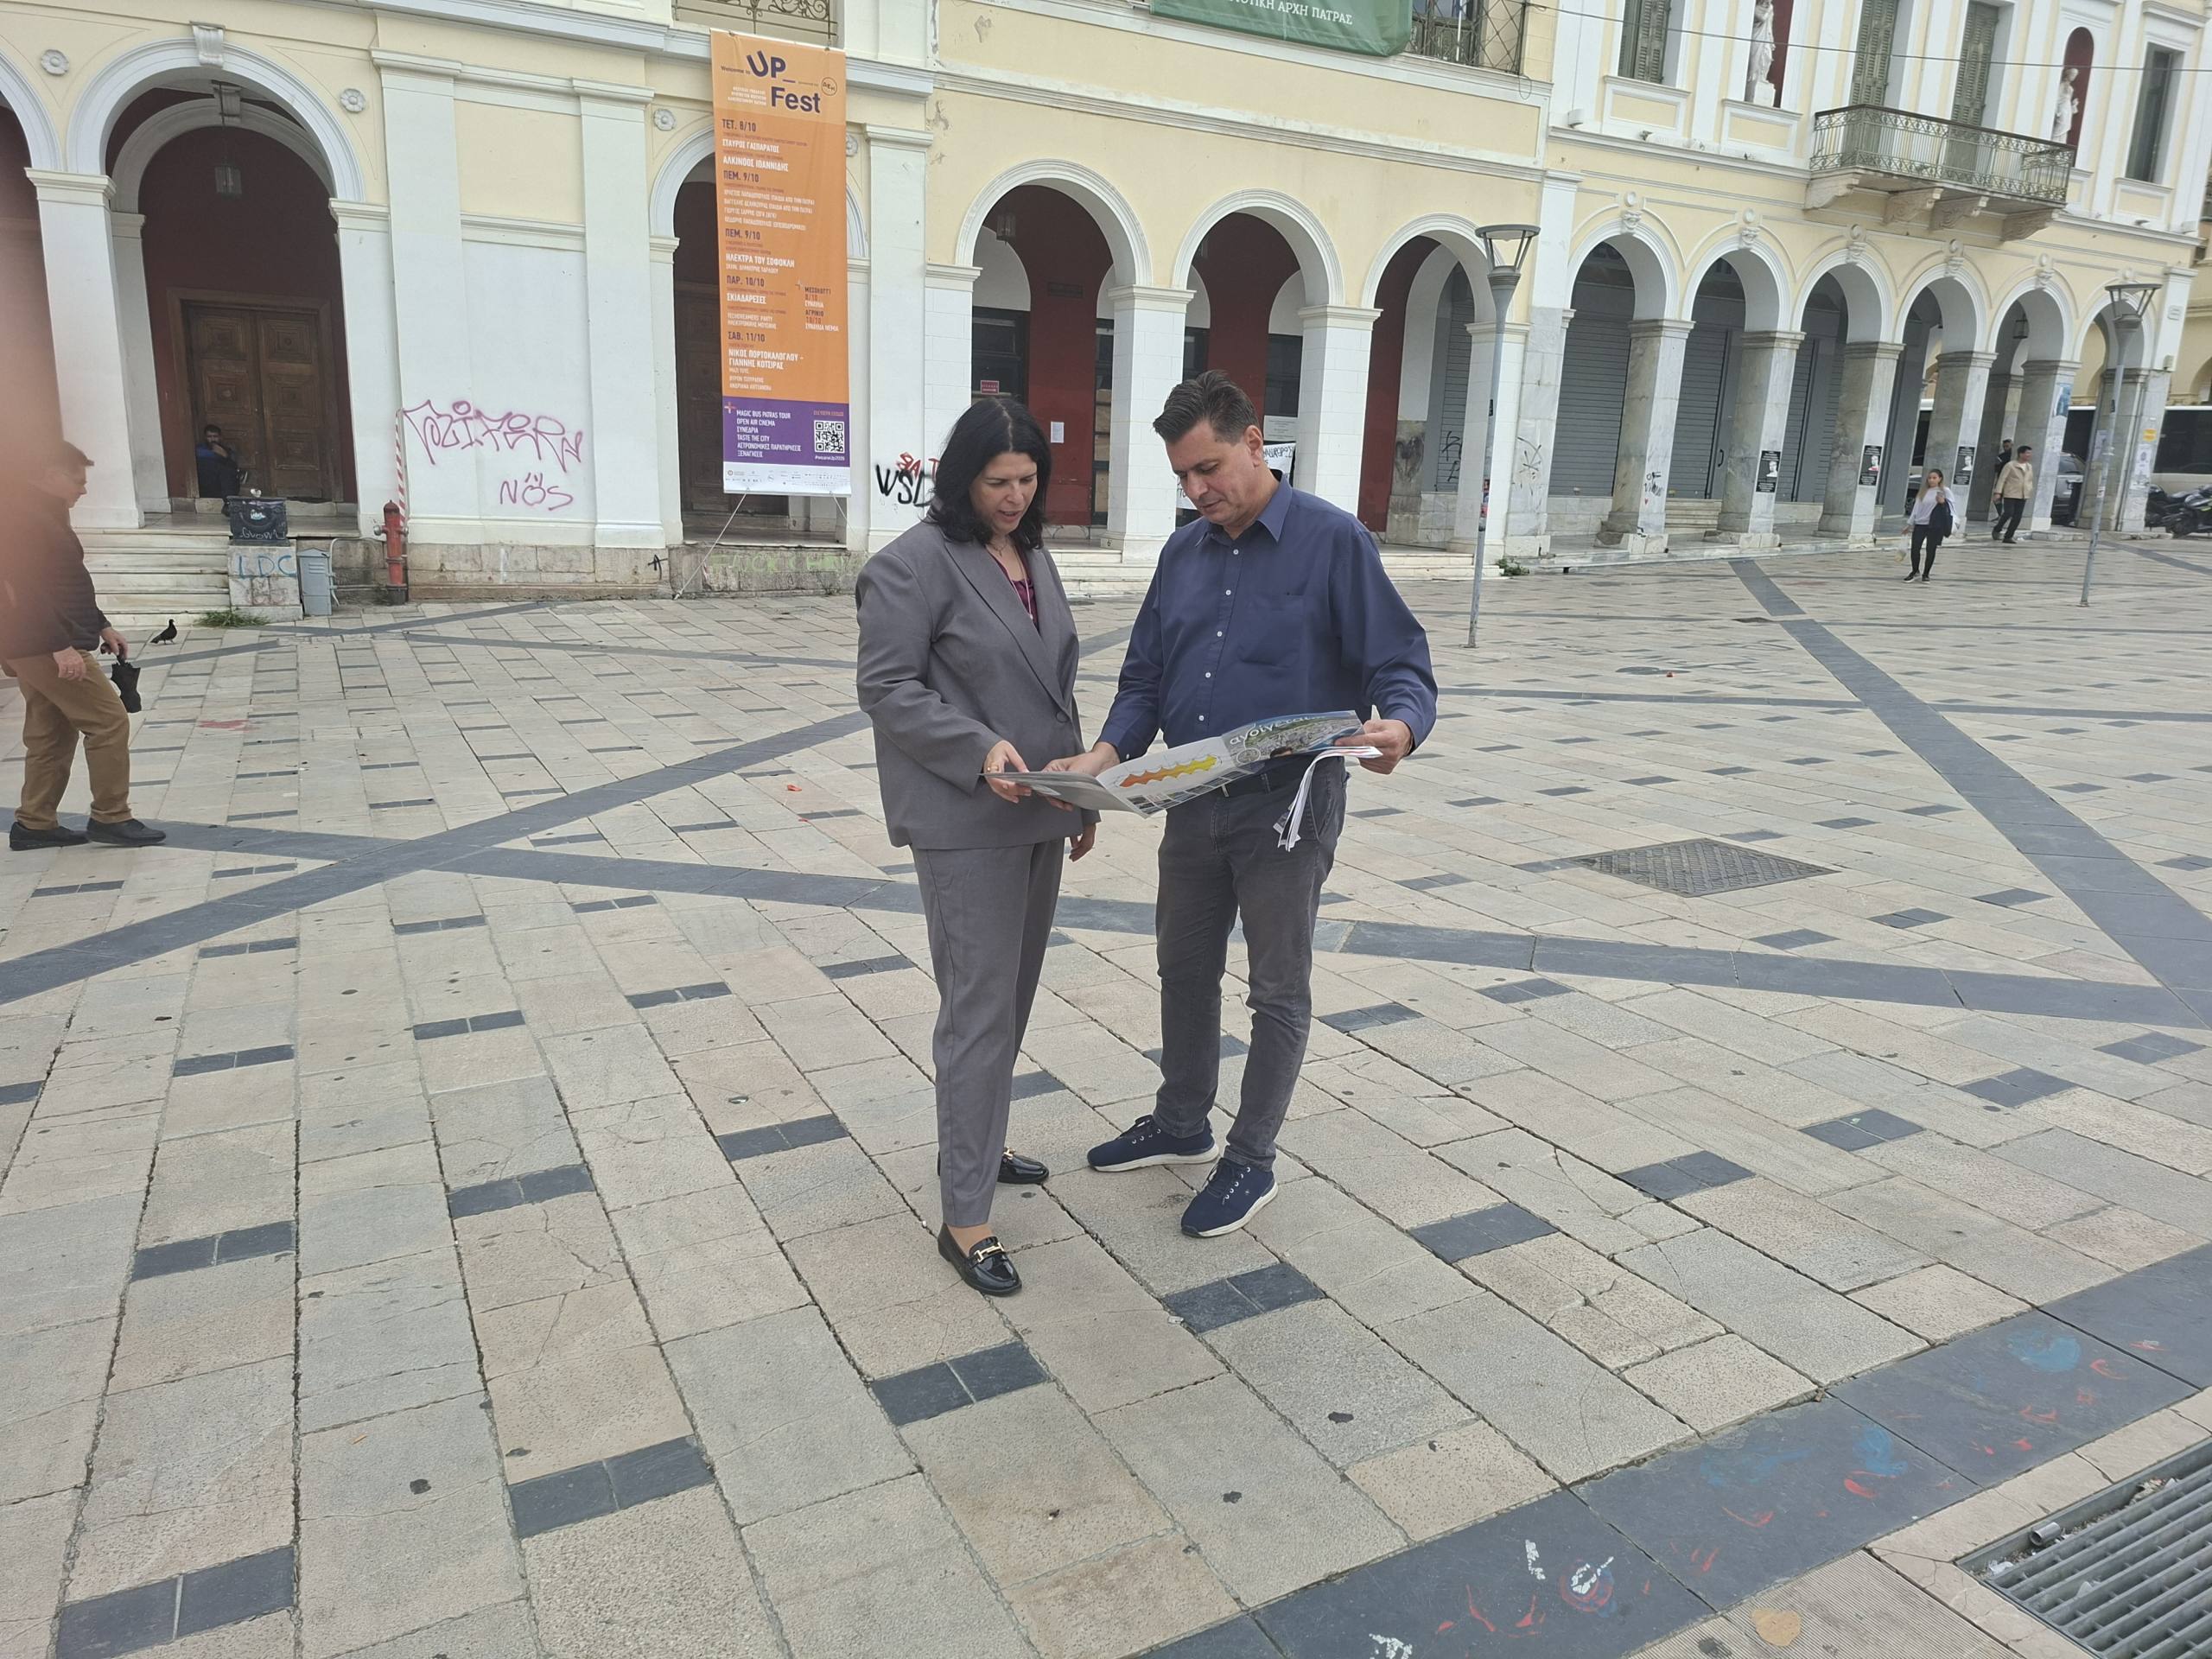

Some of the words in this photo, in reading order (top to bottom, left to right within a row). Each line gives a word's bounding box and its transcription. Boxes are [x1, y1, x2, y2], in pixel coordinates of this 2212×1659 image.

[1278, 2, 1308, 16] ΑΡΧΗ
[1312, 7, 1353, 25] ΠΑΤΡΑΣ
[771, 86, 821, 114] Fest
[740, 121, 756, 132] 8/10
[743, 172, 760, 182] 9/10
[745, 230, 760, 240] 9/10
[726, 253, 753, 264] ΗΛΕΚΤΡΑ
[727, 276, 743, 285] ΠΑΡ.
[746, 276, 765, 287] 10/10
[746, 333, 765, 342] 11/10
[728, 348, 747, 358] ΝΙΚΟΣ
[729, 359, 756, 368] ΓΙΑΝΝΗΣ
